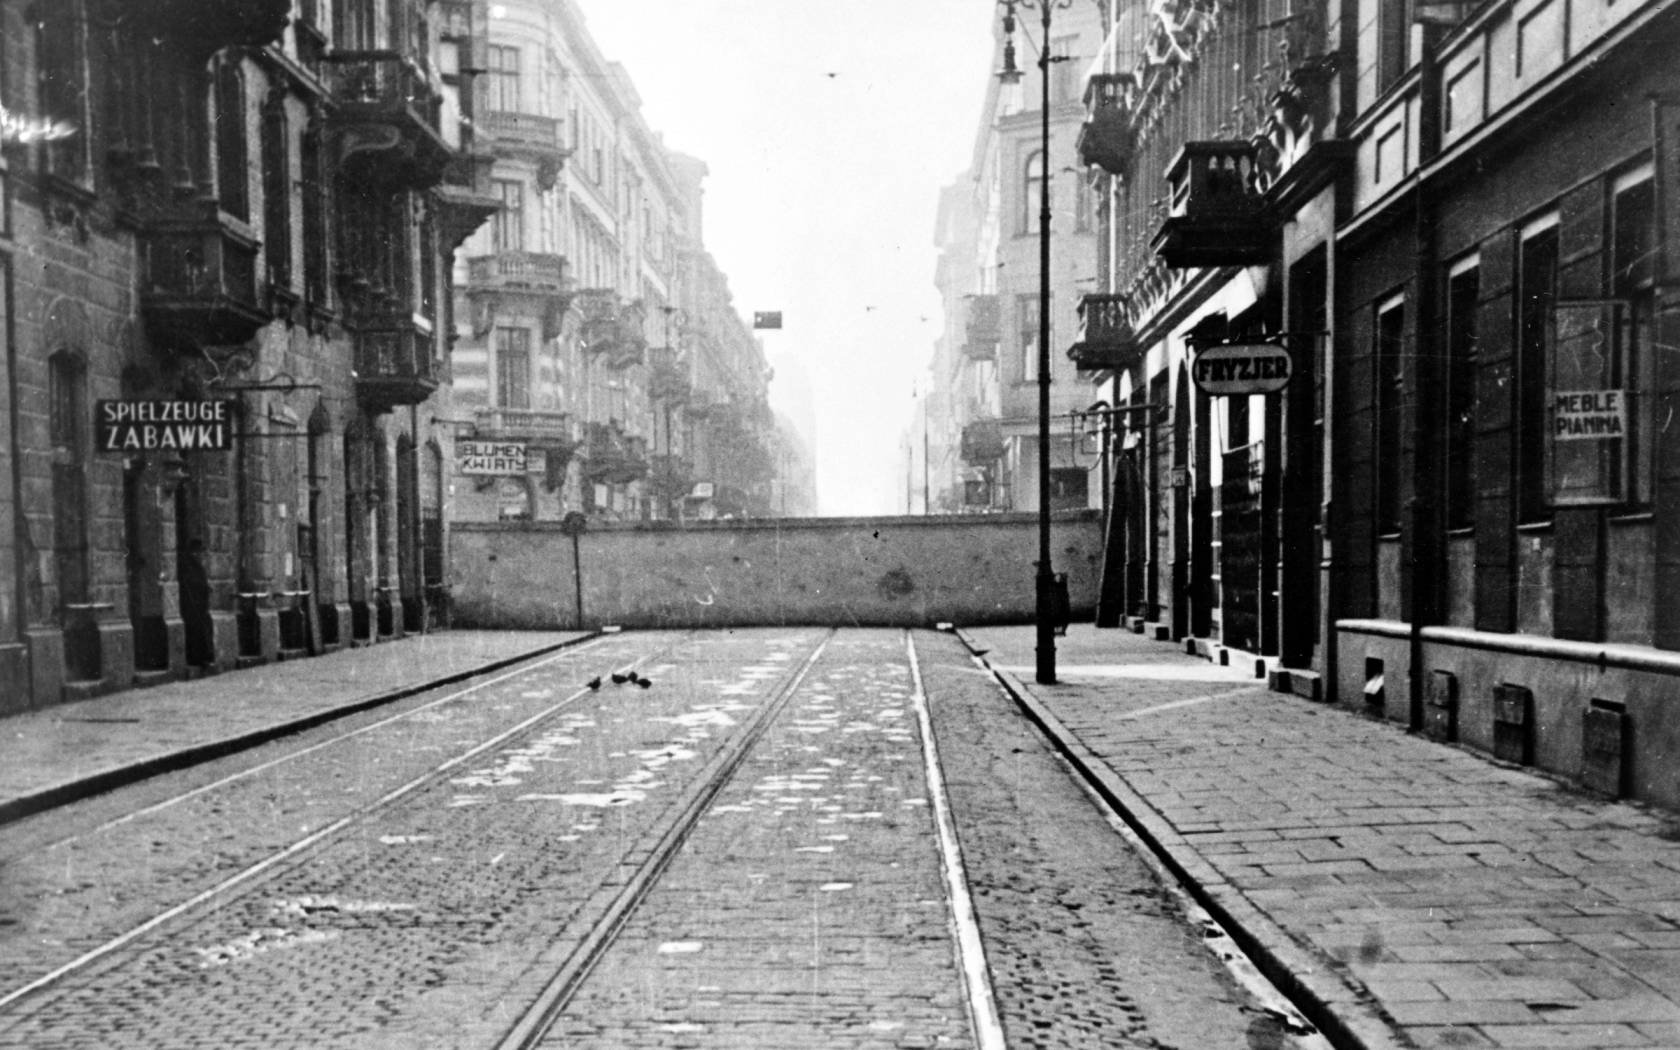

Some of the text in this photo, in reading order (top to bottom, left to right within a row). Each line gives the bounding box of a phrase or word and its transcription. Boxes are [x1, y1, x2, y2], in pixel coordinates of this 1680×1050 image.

[1199, 356, 1289, 382] FRYZJER
[104, 401, 225, 422] SPIELZEUGE
[1556, 393, 1618, 413] MEBLE
[1556, 415, 1622, 436] PIANINA
[106, 424, 223, 449] ZABAWKI
[463, 444, 527, 457] BLUMEN
[463, 457, 528, 471] KWIATY
